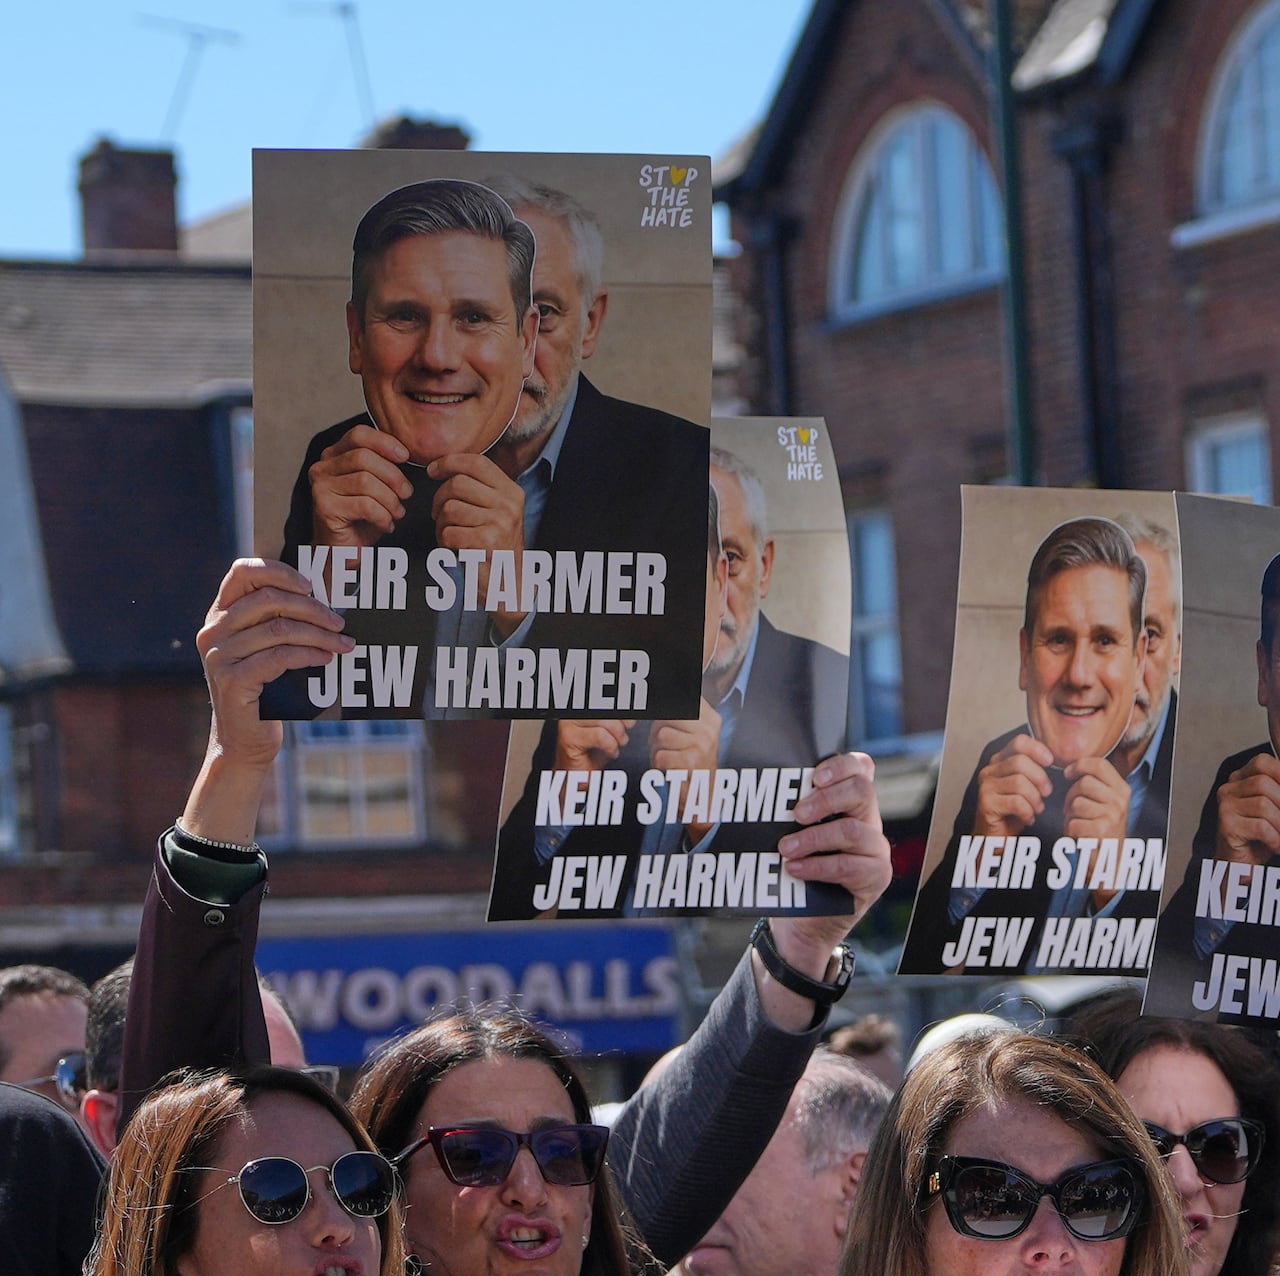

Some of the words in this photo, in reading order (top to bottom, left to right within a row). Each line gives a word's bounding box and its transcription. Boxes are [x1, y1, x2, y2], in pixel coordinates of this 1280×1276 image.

[640, 205, 693, 228] HATE
[647, 185, 690, 207] THE
[785, 445, 818, 464] THE
[787, 462, 823, 482] HATE
[297, 544, 408, 611] KEIR
[425, 548, 667, 616] STARMER
[307, 643, 418, 709] JEW
[434, 645, 650, 711] HARMER
[535, 770, 628, 827] KEIR
[532, 855, 627, 910] JEW
[633, 852, 807, 909] HARMER
[951, 835, 1041, 889] KEIR
[941, 917, 1035, 968] JEW
[1035, 917, 1157, 968] HARM
[270, 956, 680, 1031] WOODALLS
